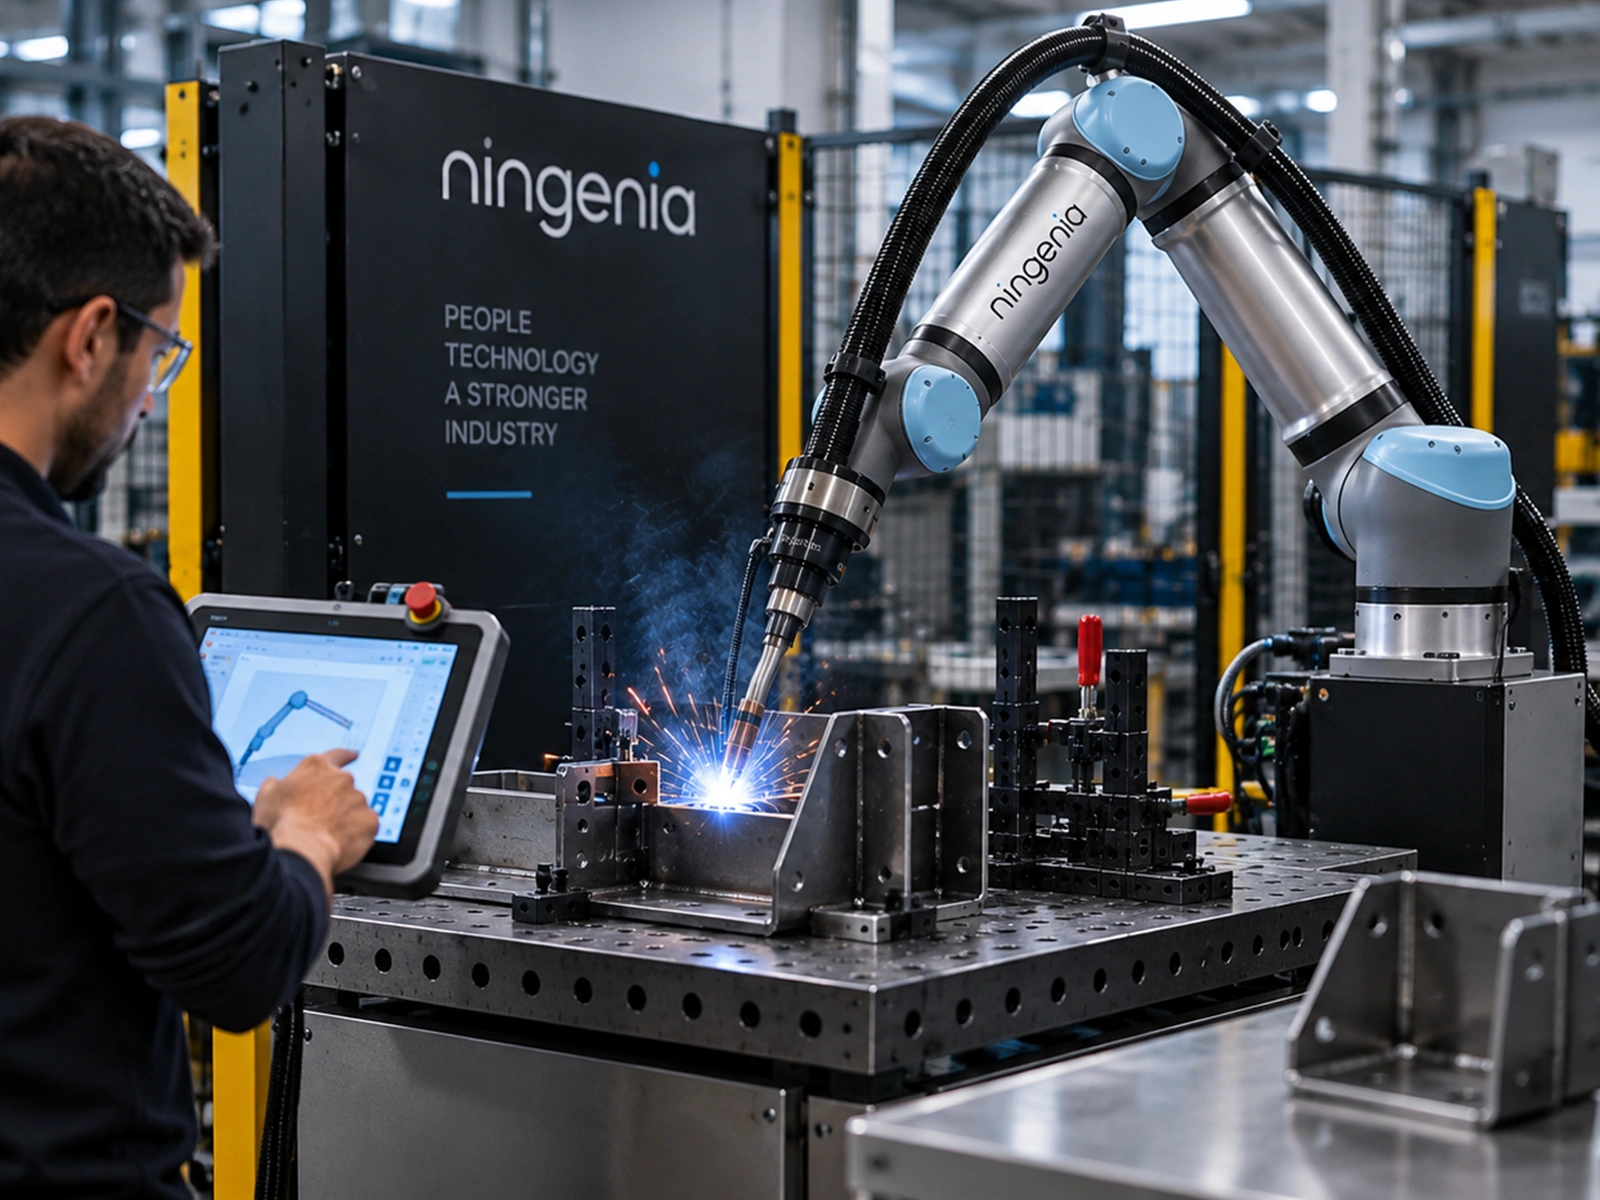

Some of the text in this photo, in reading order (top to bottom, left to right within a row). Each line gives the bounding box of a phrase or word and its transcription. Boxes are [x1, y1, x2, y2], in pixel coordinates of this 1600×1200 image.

[442, 136, 696, 238] ningenia
[990, 204, 1088, 320] ningenia
[444, 304, 532, 334] PEOPLE
[444, 342, 599, 375] TECHNOLOGY
[444, 381, 588, 411] A STRONGER
[445, 420, 558, 446] INDUSTRY
